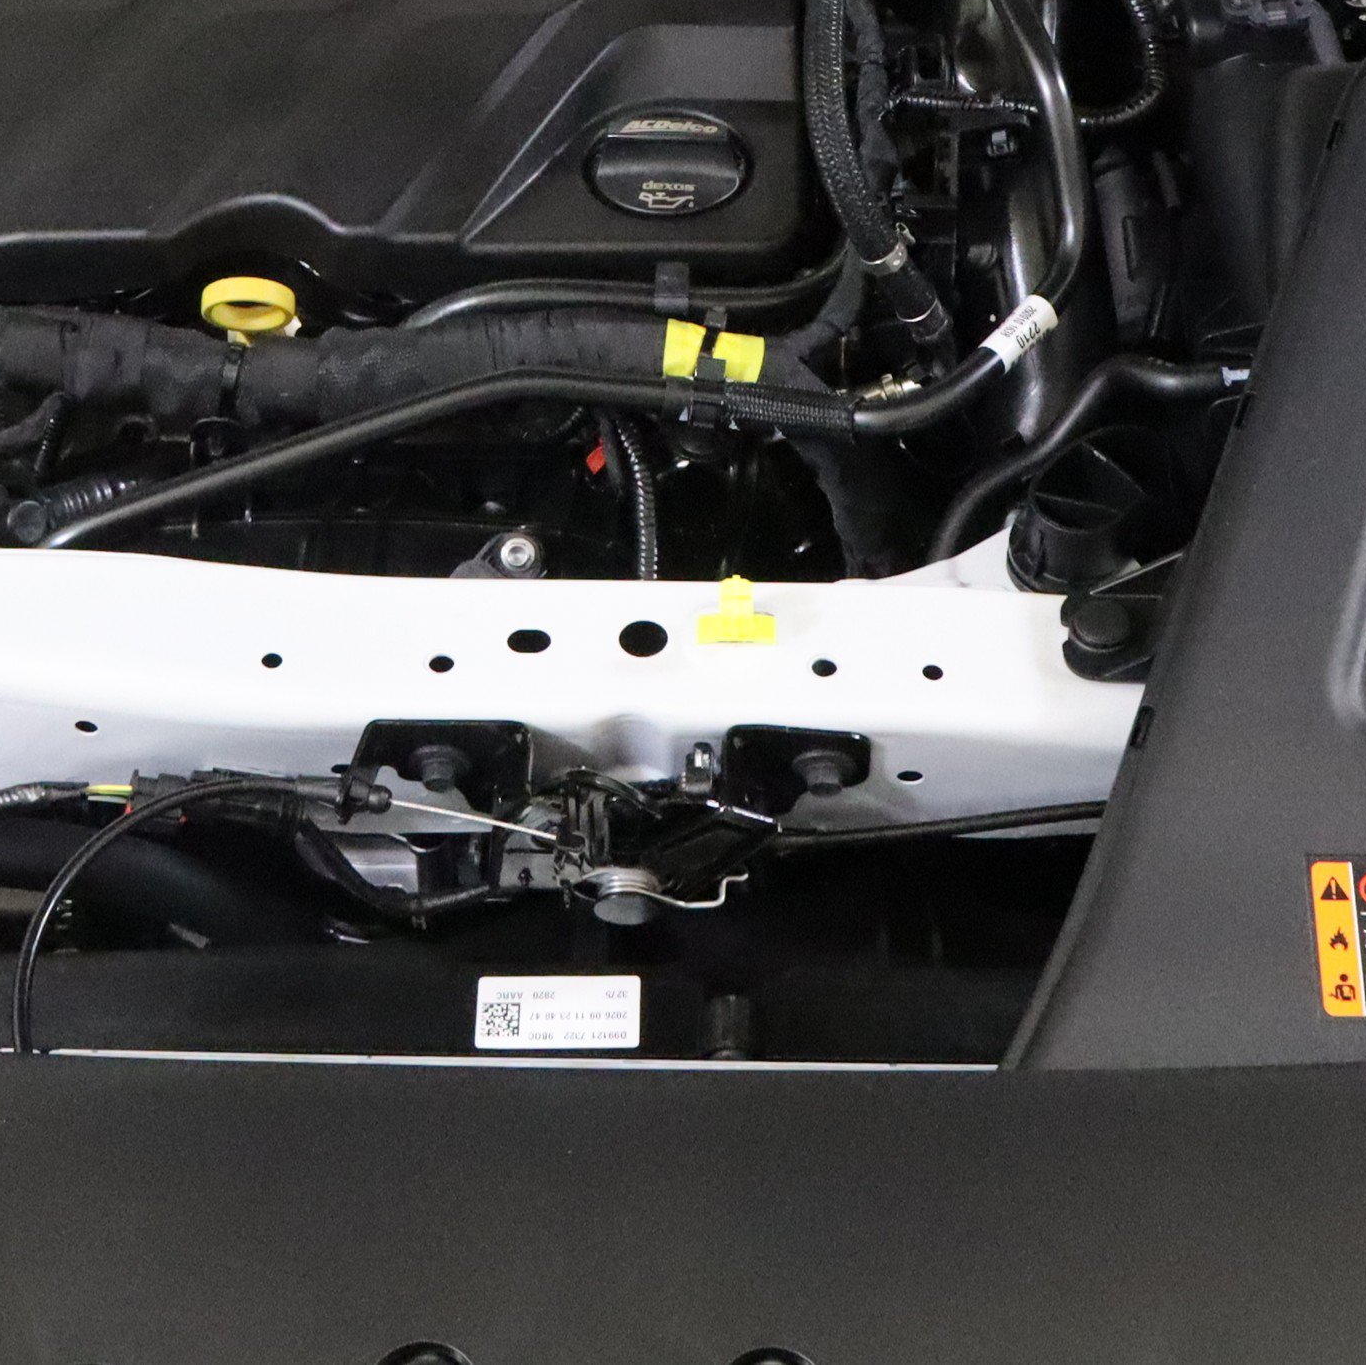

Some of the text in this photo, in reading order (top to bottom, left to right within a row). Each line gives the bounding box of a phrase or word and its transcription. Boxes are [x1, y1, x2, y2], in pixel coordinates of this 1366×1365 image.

[619, 120, 718, 134] ACDelco
[642, 180, 695, 192] dexos
[1016, 321, 1041, 349] 2210
